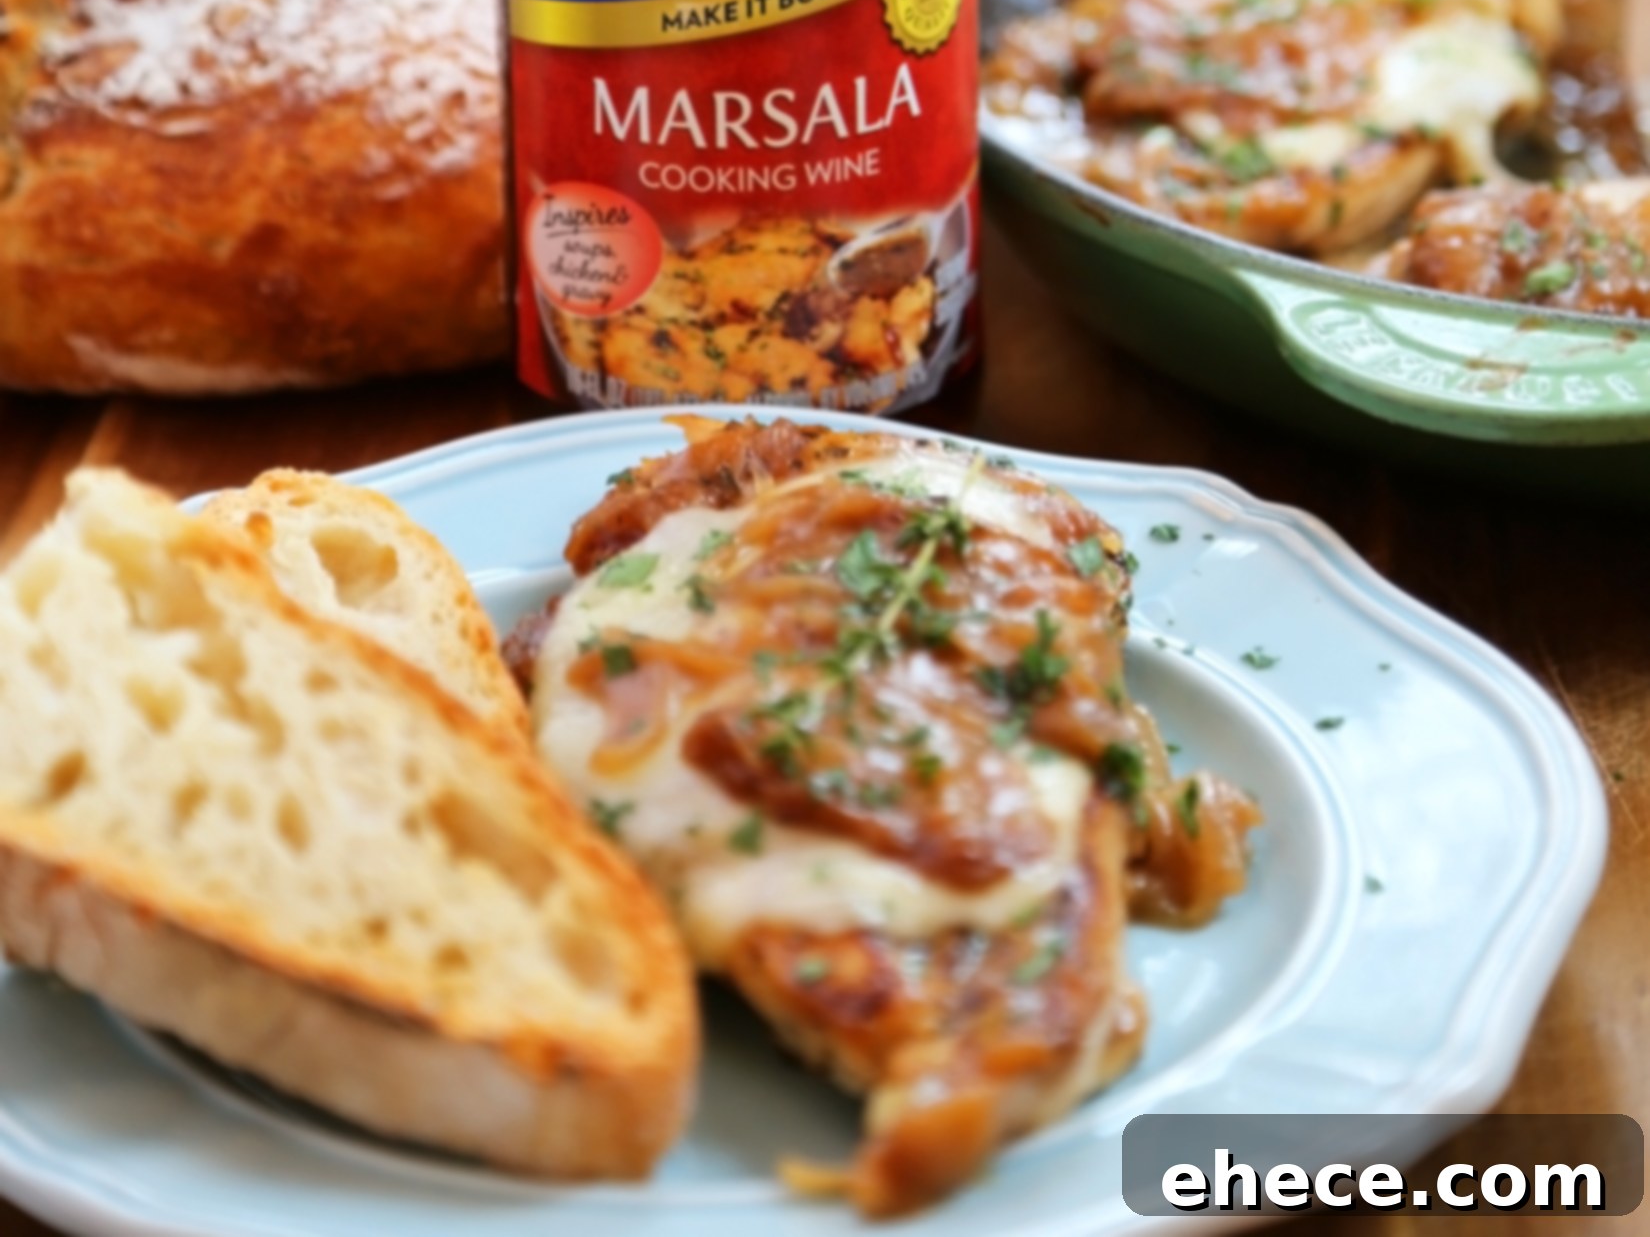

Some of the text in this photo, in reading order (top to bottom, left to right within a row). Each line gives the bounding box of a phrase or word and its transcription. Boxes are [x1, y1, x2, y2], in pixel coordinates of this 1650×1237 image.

[661, 0, 738, 33] MAKE
[593, 62, 922, 150] MARSALA
[638, 147, 880, 194] COOKING WINE
[543, 193, 632, 235] Inspires
